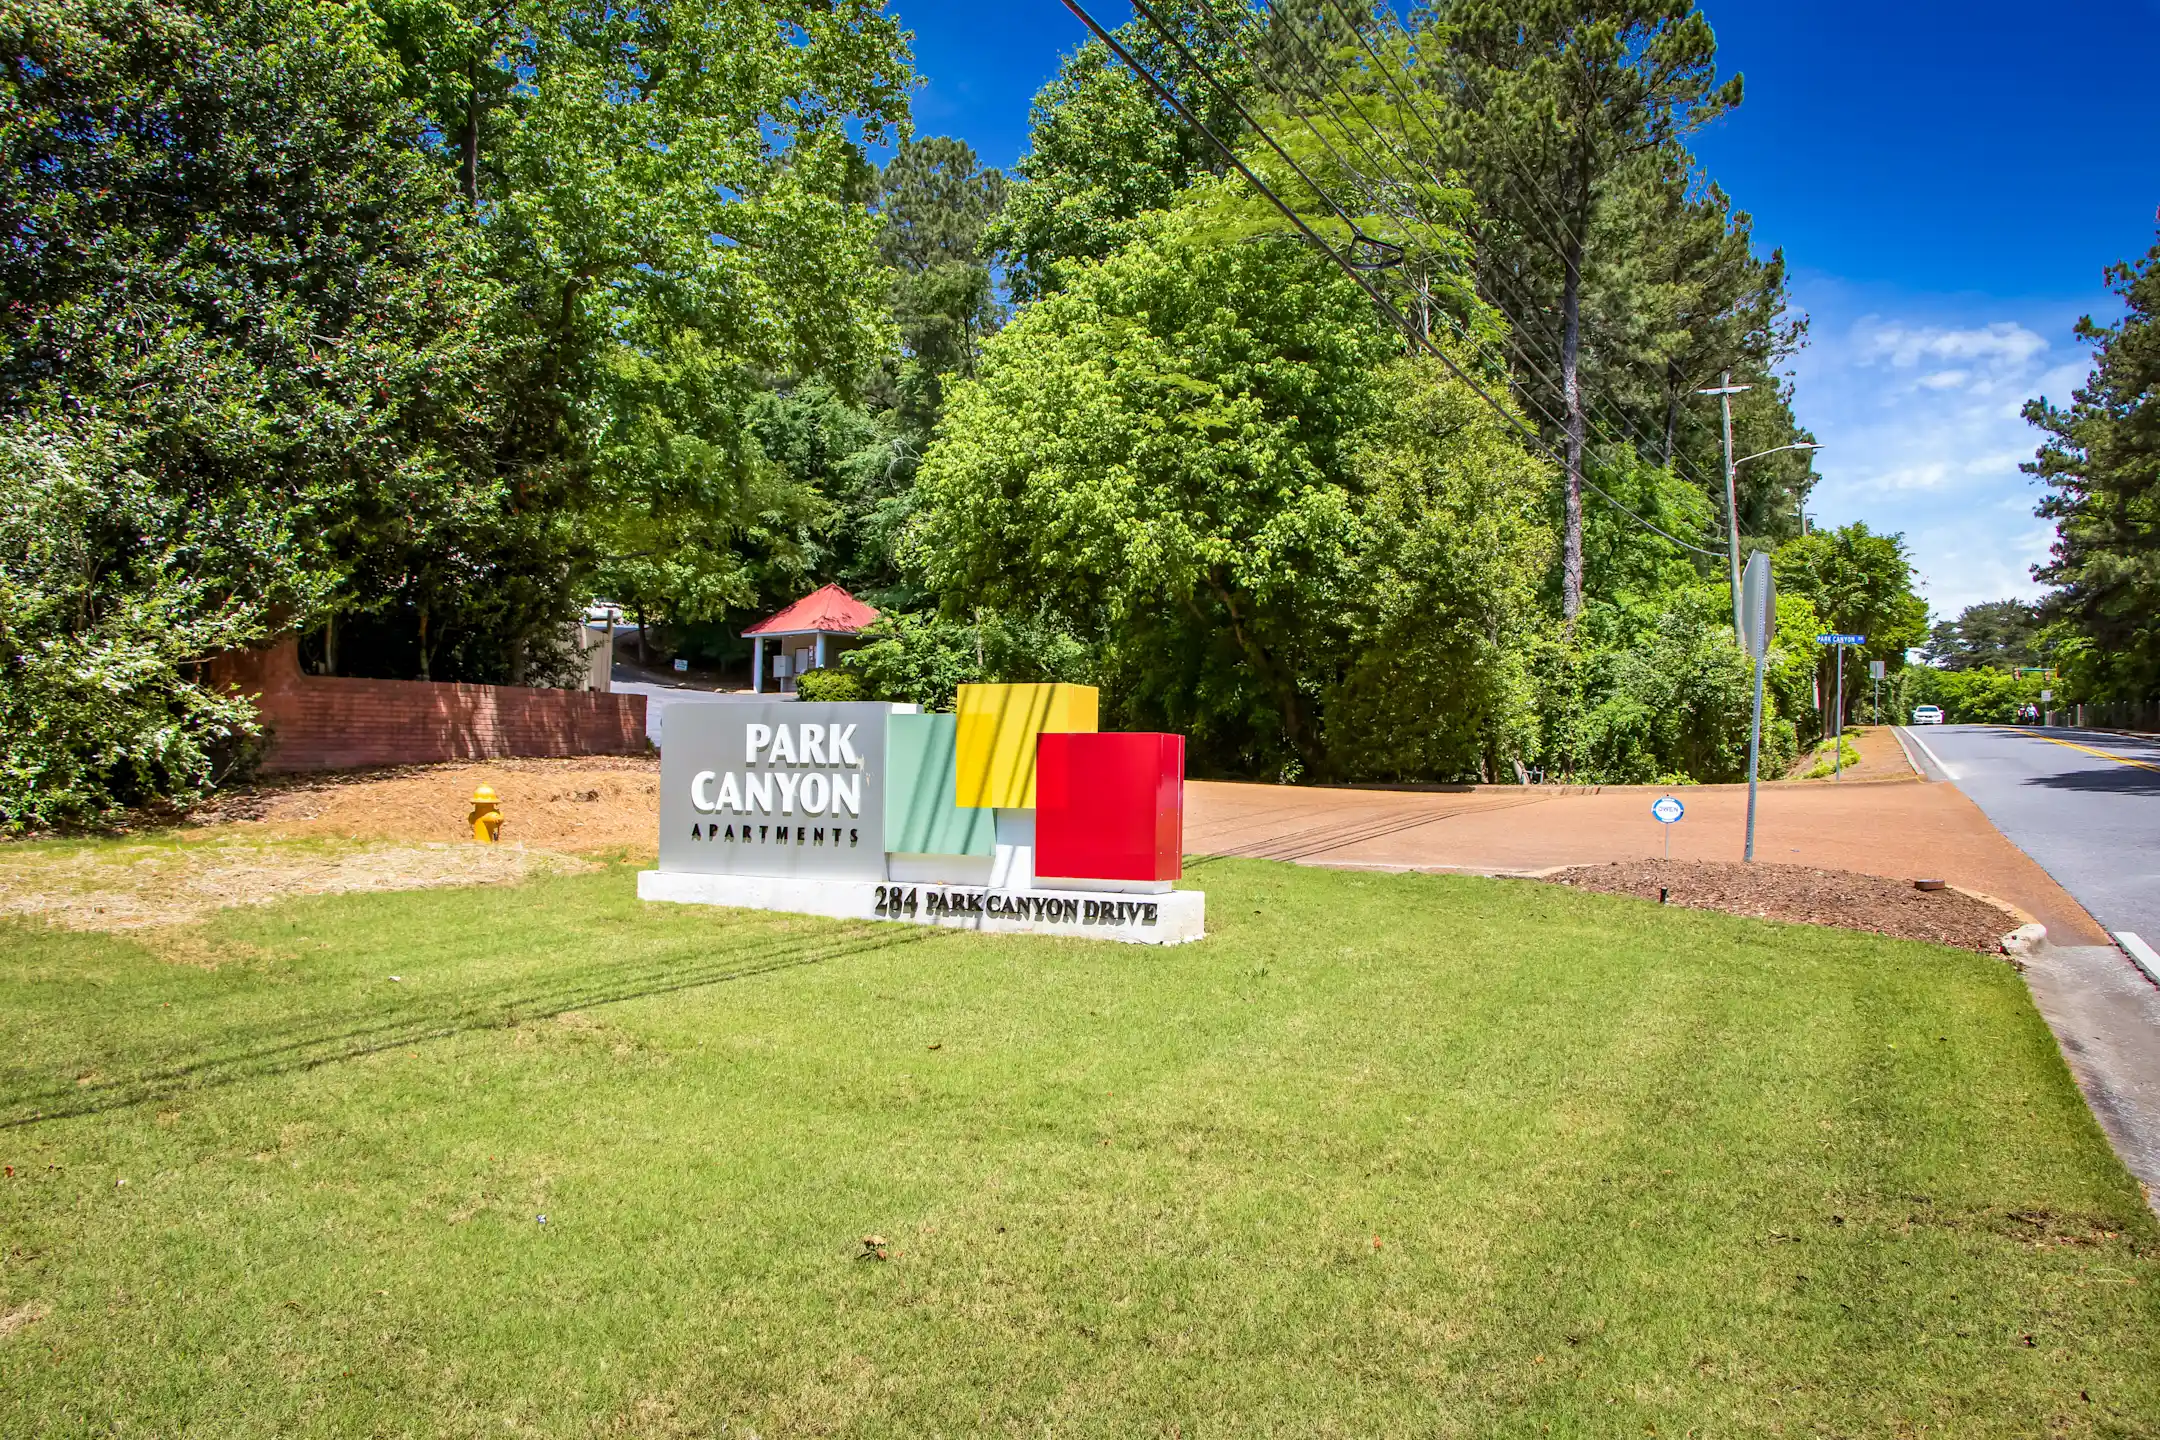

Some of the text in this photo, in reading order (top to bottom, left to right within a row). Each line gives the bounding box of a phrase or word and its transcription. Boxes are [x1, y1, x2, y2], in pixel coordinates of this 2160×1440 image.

[1816, 635, 1832, 643] PARK
[1833, 635, 1856, 643] CANYON
[746, 723, 858, 765] PARK
[690, 770, 861, 816] CANYON
[691, 823, 859, 844] APARTMENTS
[874, 886, 1158, 921] 284 PARK CANYON DRIVE
